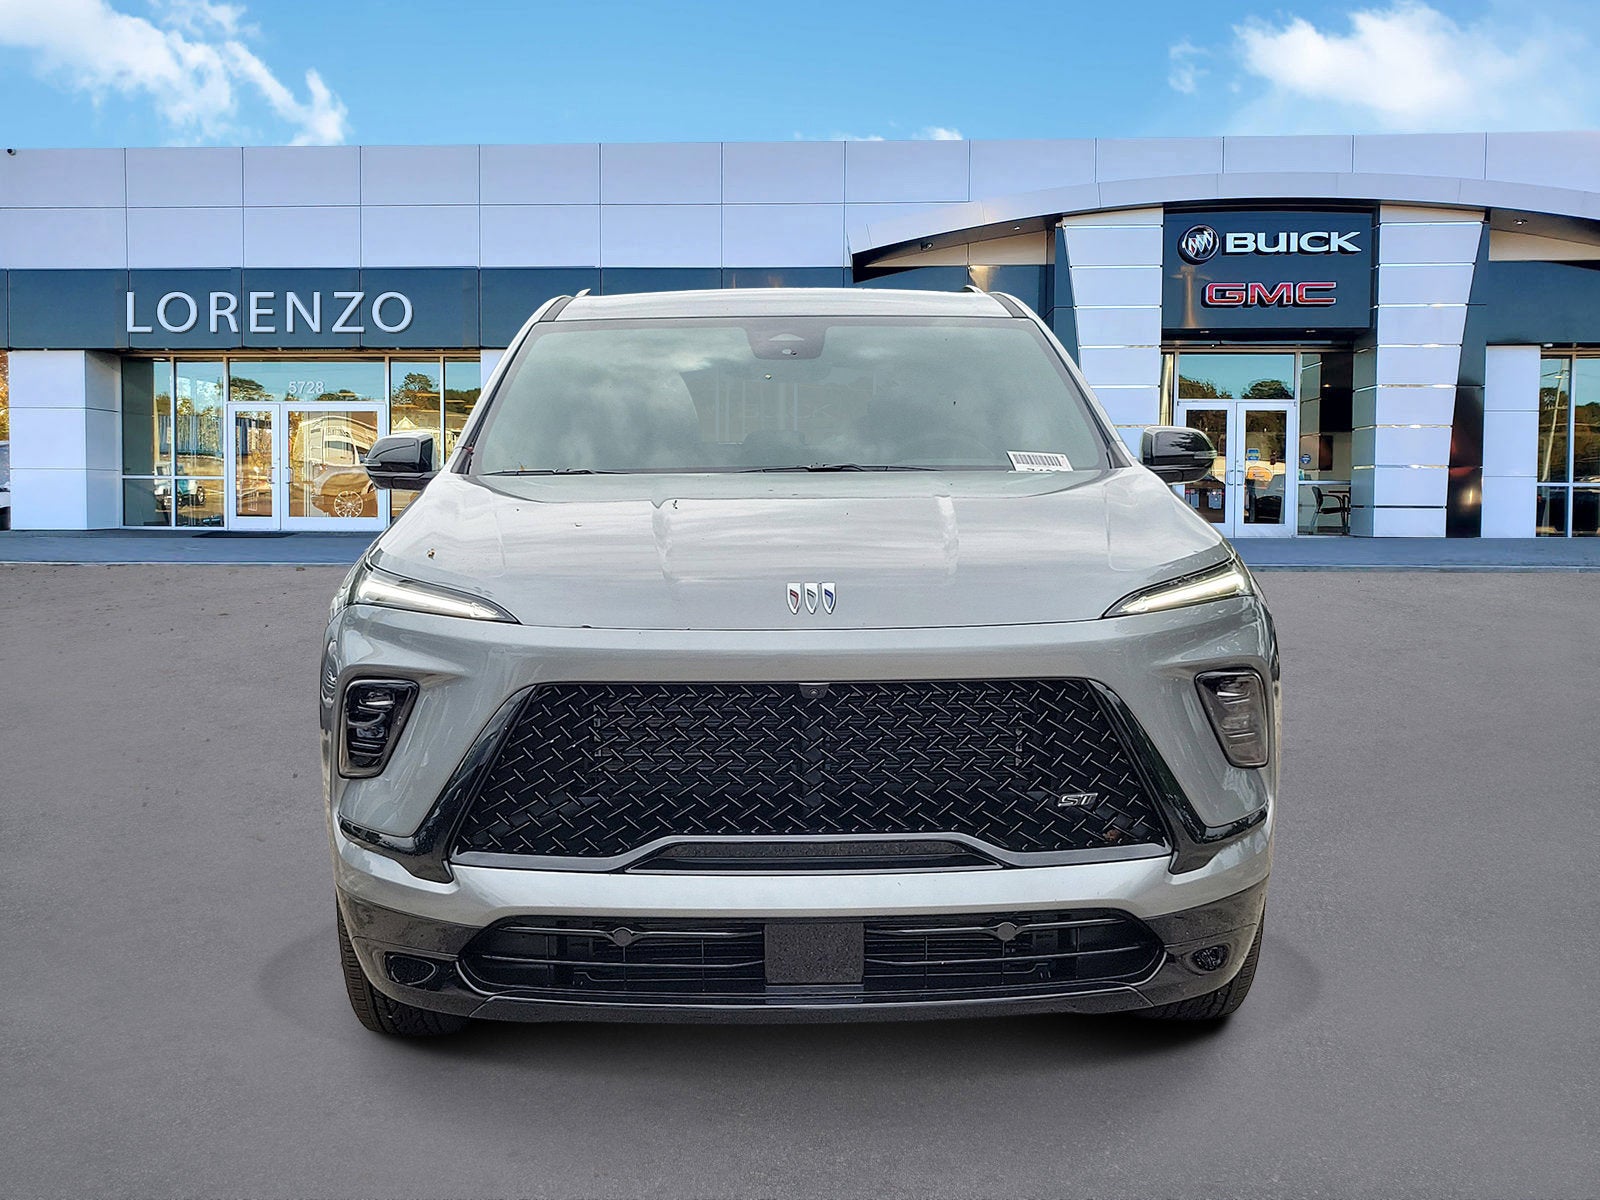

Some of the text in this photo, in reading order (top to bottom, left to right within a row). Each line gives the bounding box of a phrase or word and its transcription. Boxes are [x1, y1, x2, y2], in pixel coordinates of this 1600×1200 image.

[1226, 231, 1362, 253] BUICK
[1205, 281, 1337, 305] GMC
[126, 291, 413, 333] LORENZO
[288, 381, 325, 394] 5728
